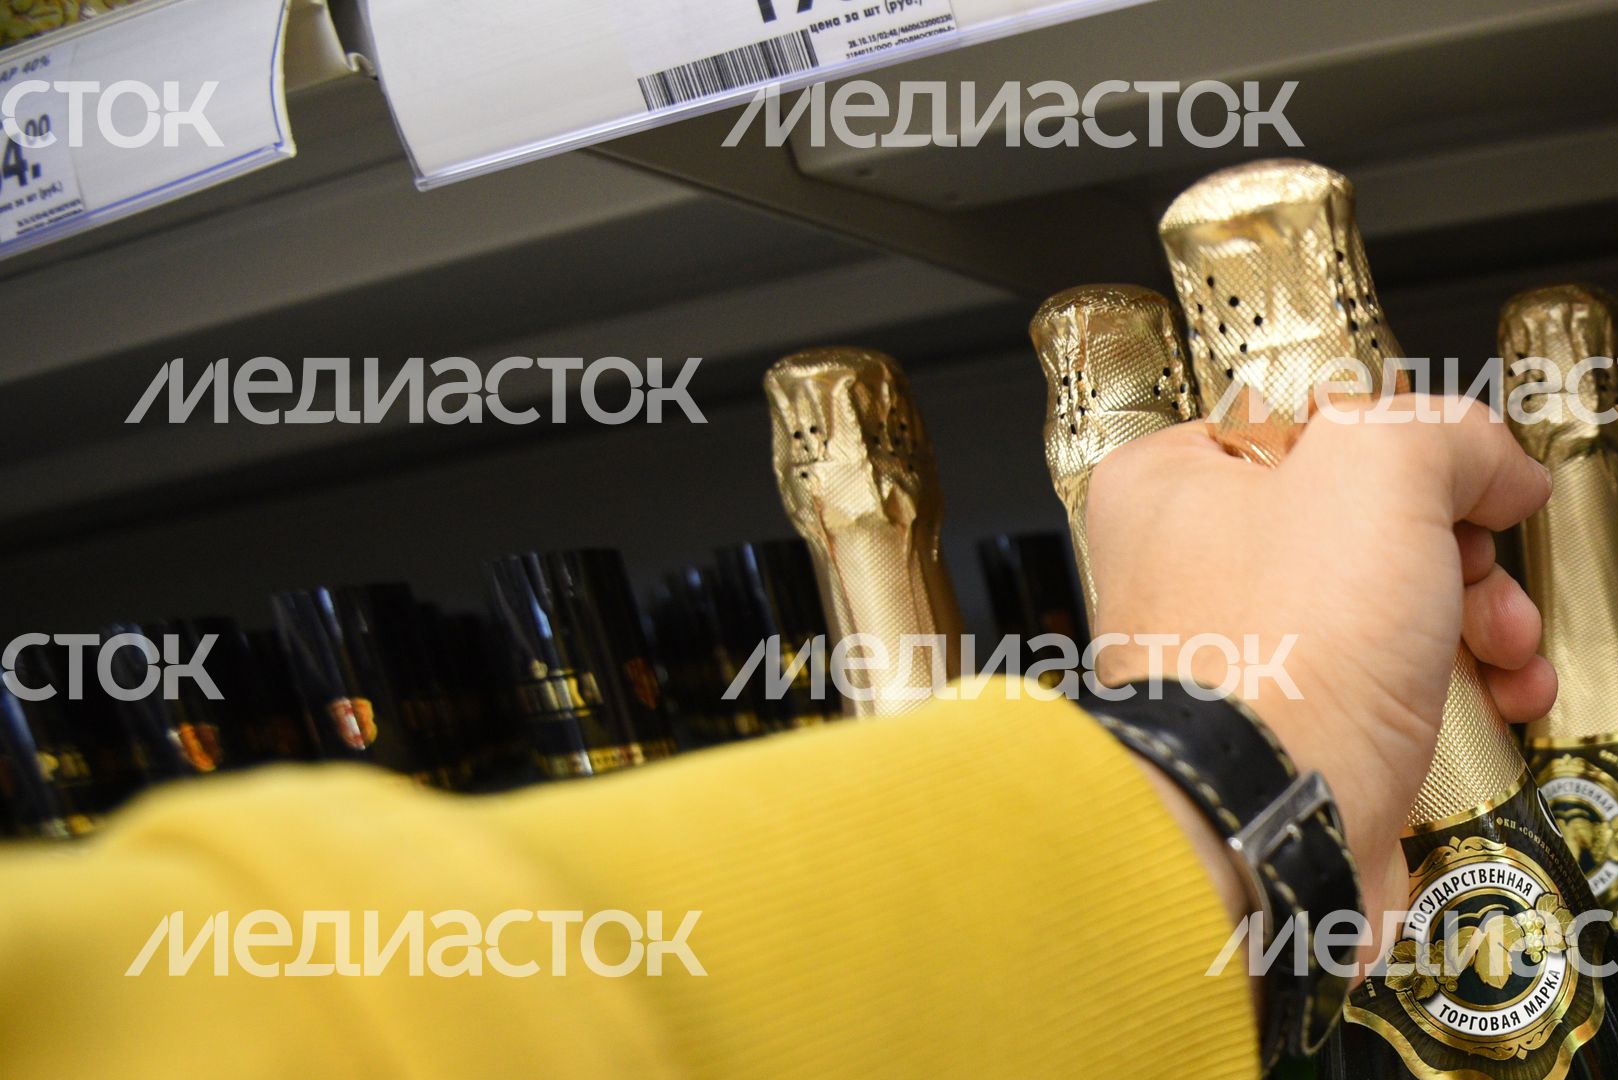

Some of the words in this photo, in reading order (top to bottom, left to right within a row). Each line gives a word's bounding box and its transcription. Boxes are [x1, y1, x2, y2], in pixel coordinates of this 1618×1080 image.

[810, 17, 841, 33] цена
[845, 12, 859, 23] за
[864, 5, 880, 18] шт
[1409, 868, 1533, 933] ГОСУДАРСТВЕННАЯ
[1439, 1004, 1522, 1032] ТОРГОВАЯ
[1523, 969, 1561, 1018] МАРКА
